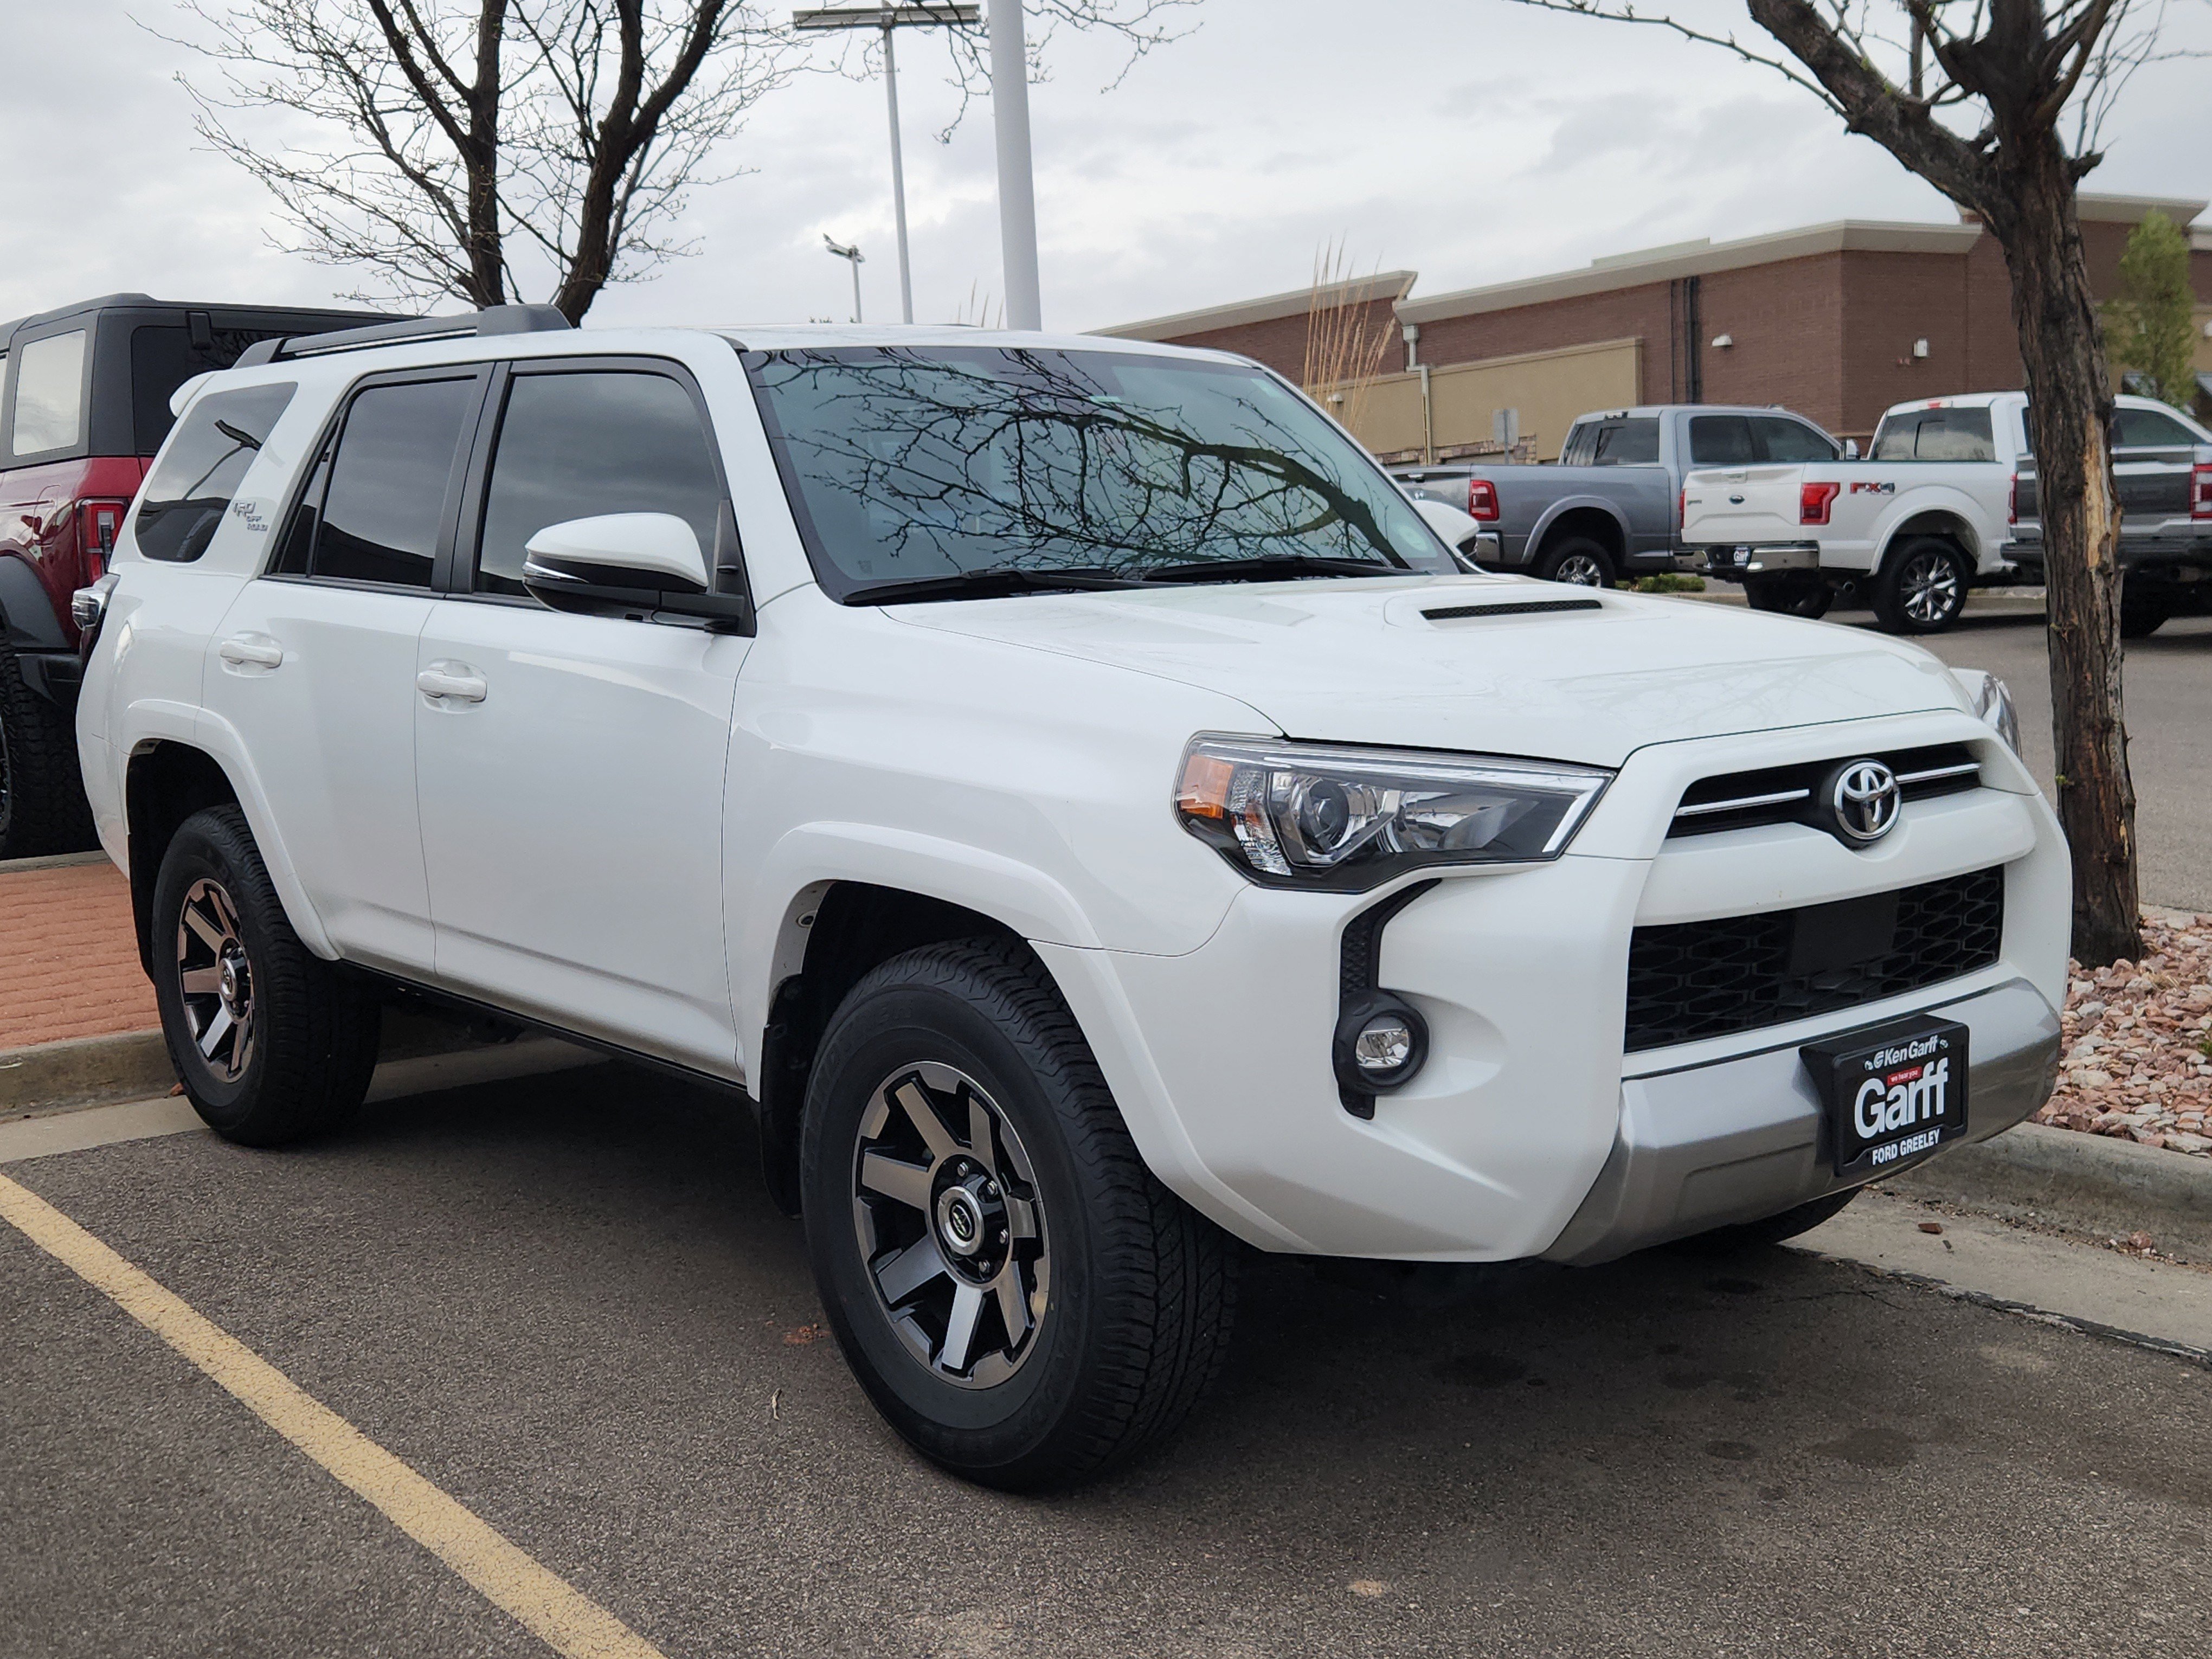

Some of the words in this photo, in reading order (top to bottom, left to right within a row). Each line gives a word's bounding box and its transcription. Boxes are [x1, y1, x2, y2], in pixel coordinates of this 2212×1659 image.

[1850, 483, 1895, 494] FX4
[1855, 1057, 1949, 1139] Garff
[1872, 1143, 1898, 1166] FORD
[1900, 1128, 1940, 1156] GREELEY
